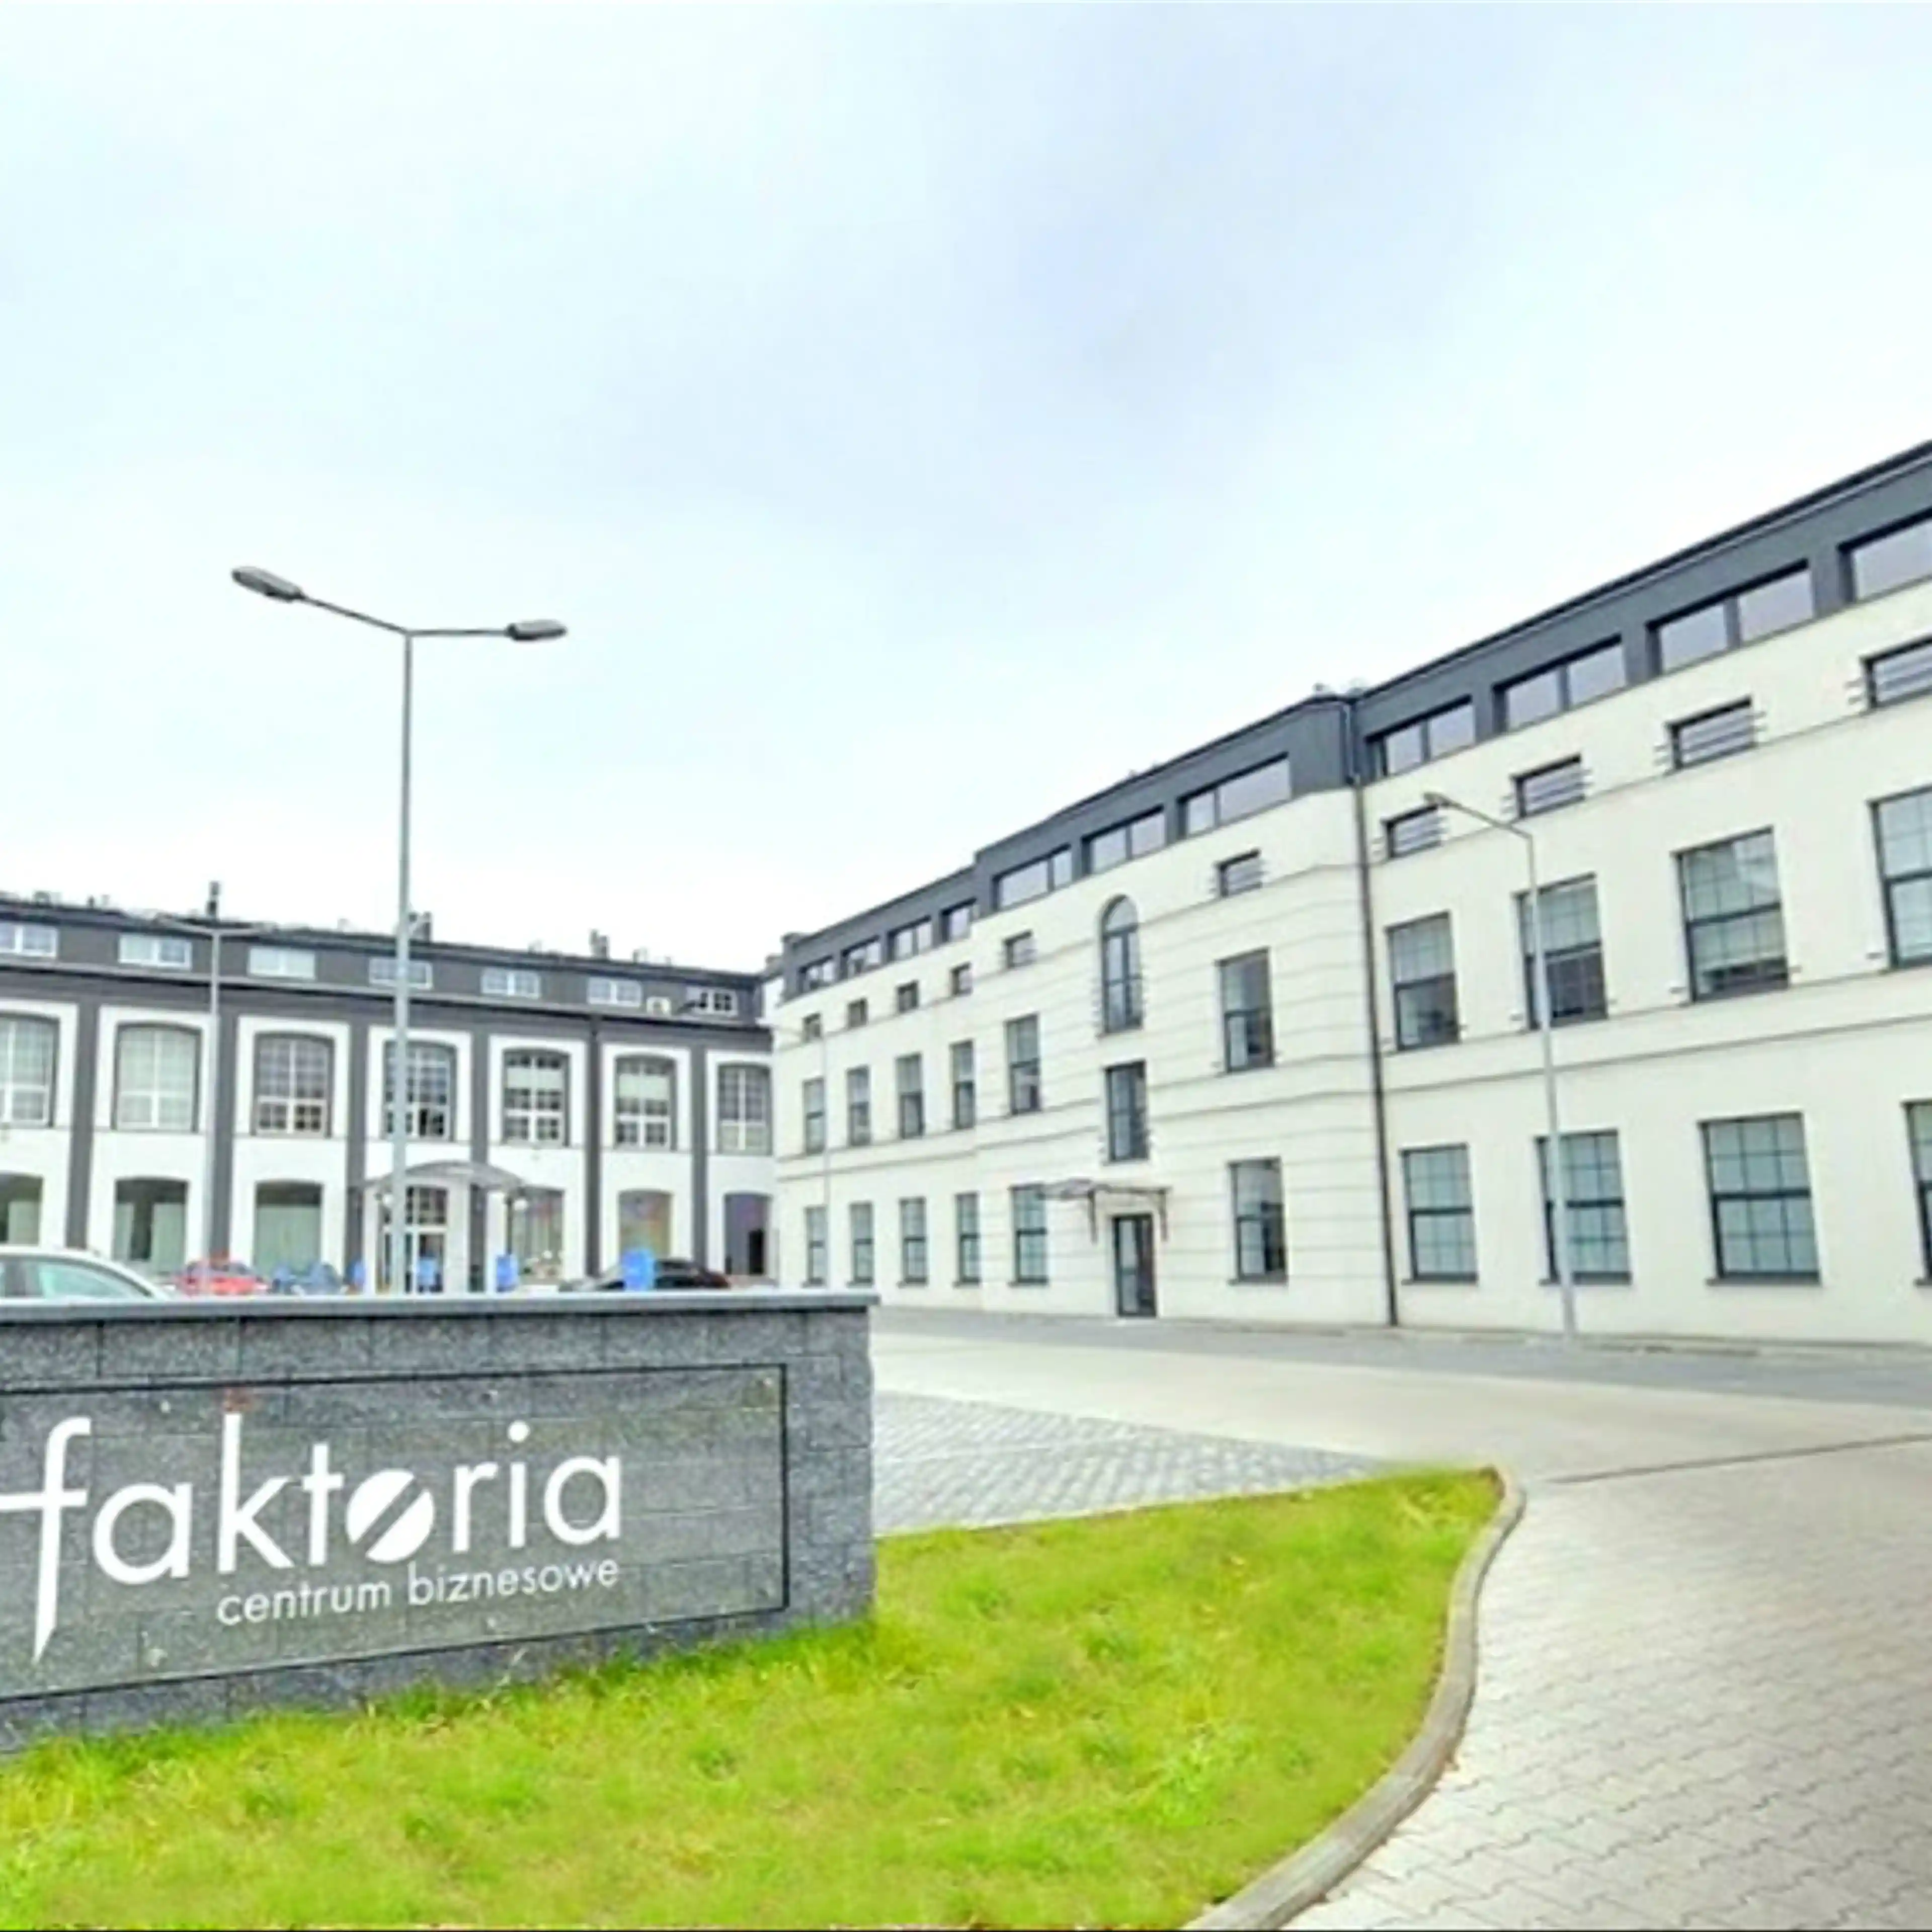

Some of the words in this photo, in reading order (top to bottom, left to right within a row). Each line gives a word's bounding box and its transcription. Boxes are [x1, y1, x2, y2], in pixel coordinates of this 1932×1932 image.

[0, 1413, 621, 1663] faktoria
[217, 1579, 391, 1626] centrum
[408, 1559, 620, 1605] biznesowe
